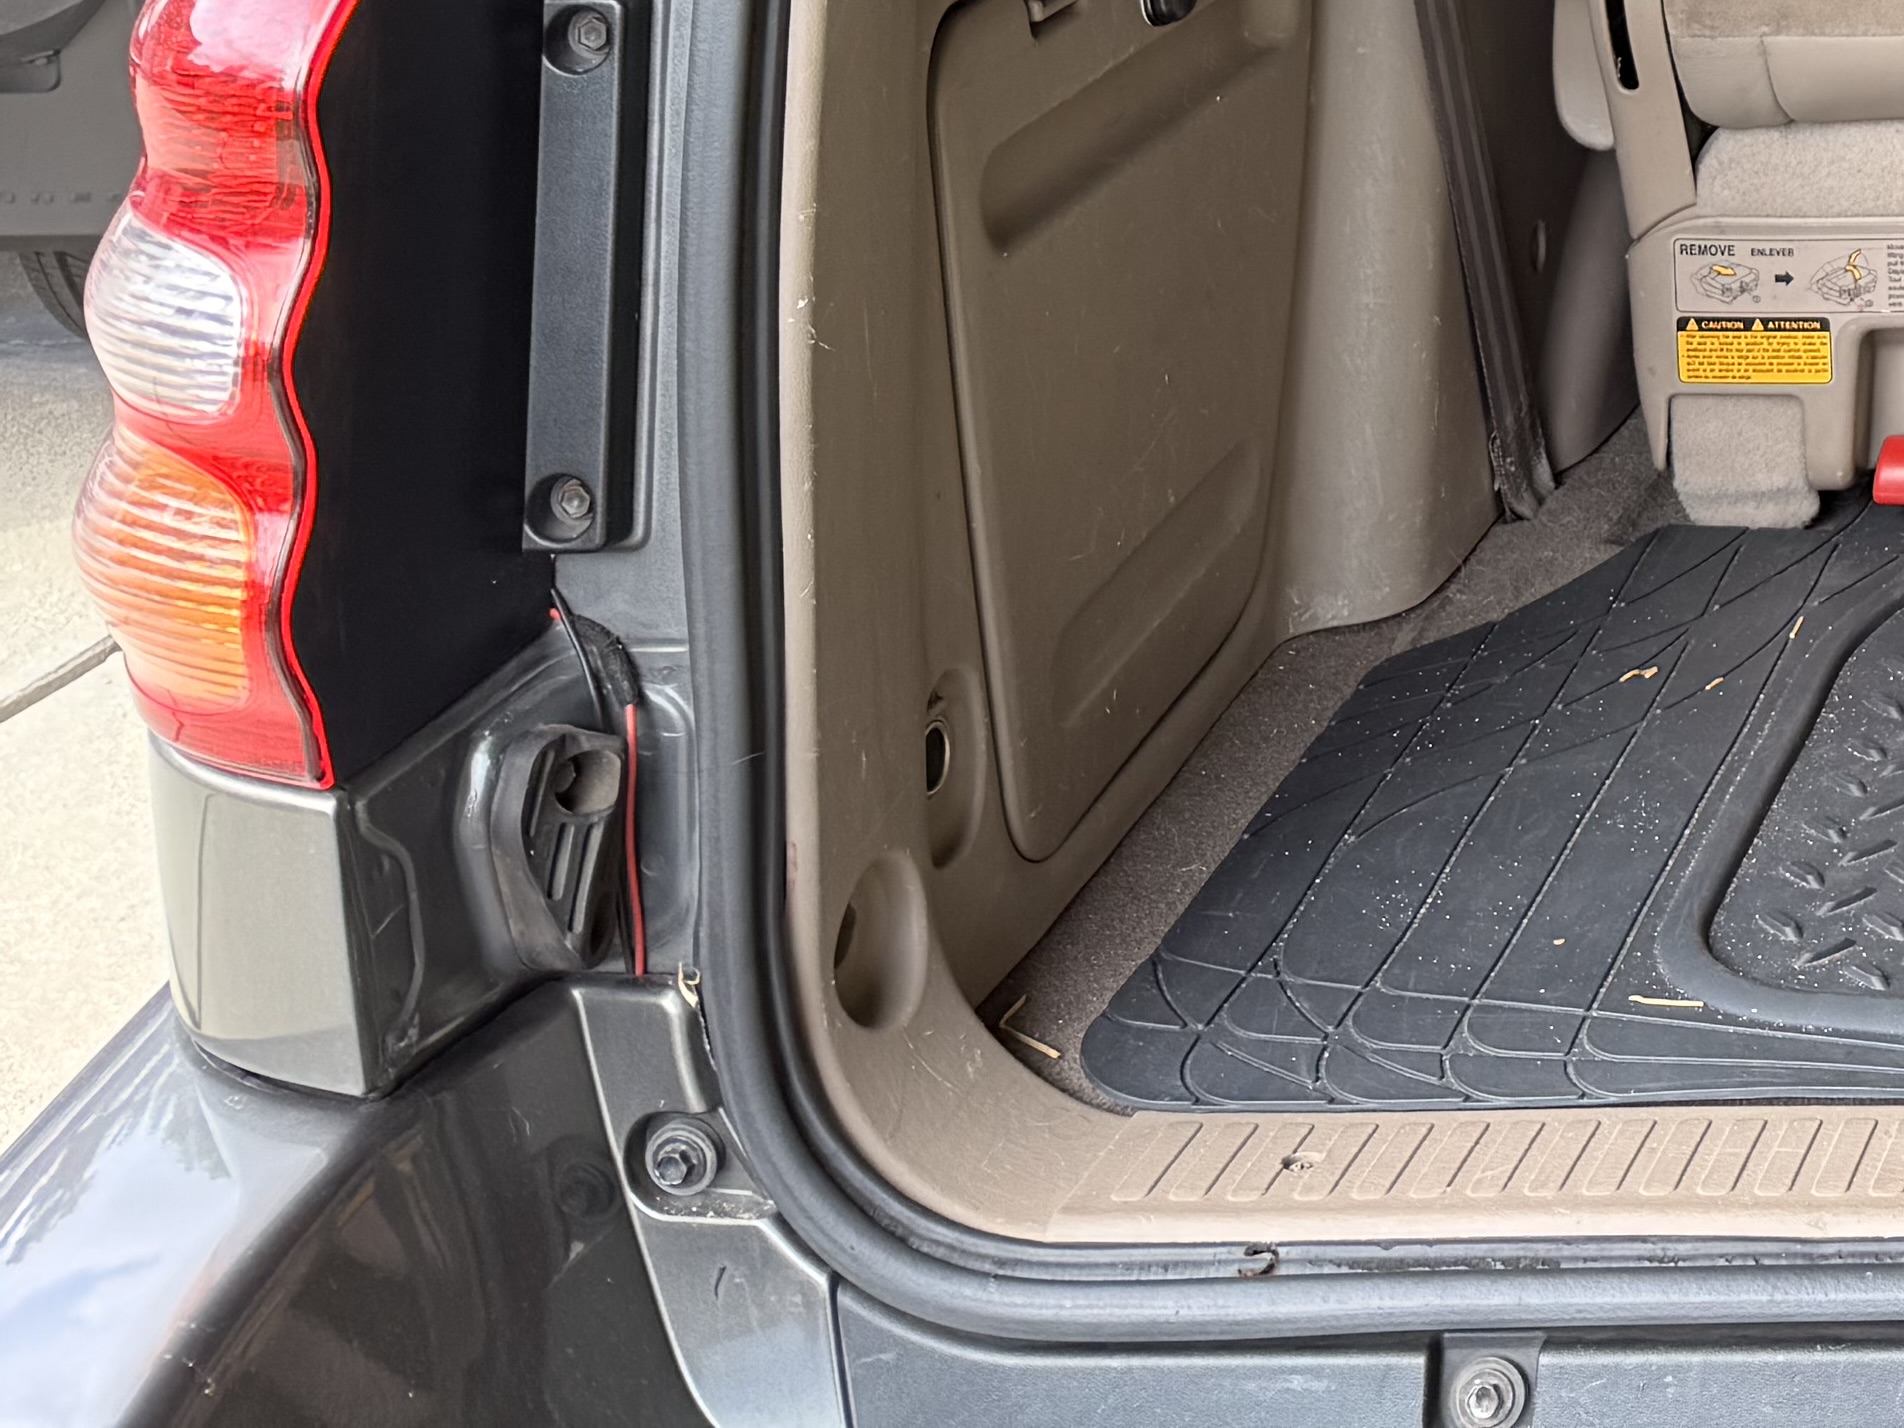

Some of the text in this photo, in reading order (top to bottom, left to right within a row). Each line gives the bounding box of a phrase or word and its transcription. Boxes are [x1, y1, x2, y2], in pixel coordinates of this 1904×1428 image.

[1680, 244, 1736, 256] REMOVE
[1702, 320, 1821, 330] CAUTION ATTENTION
